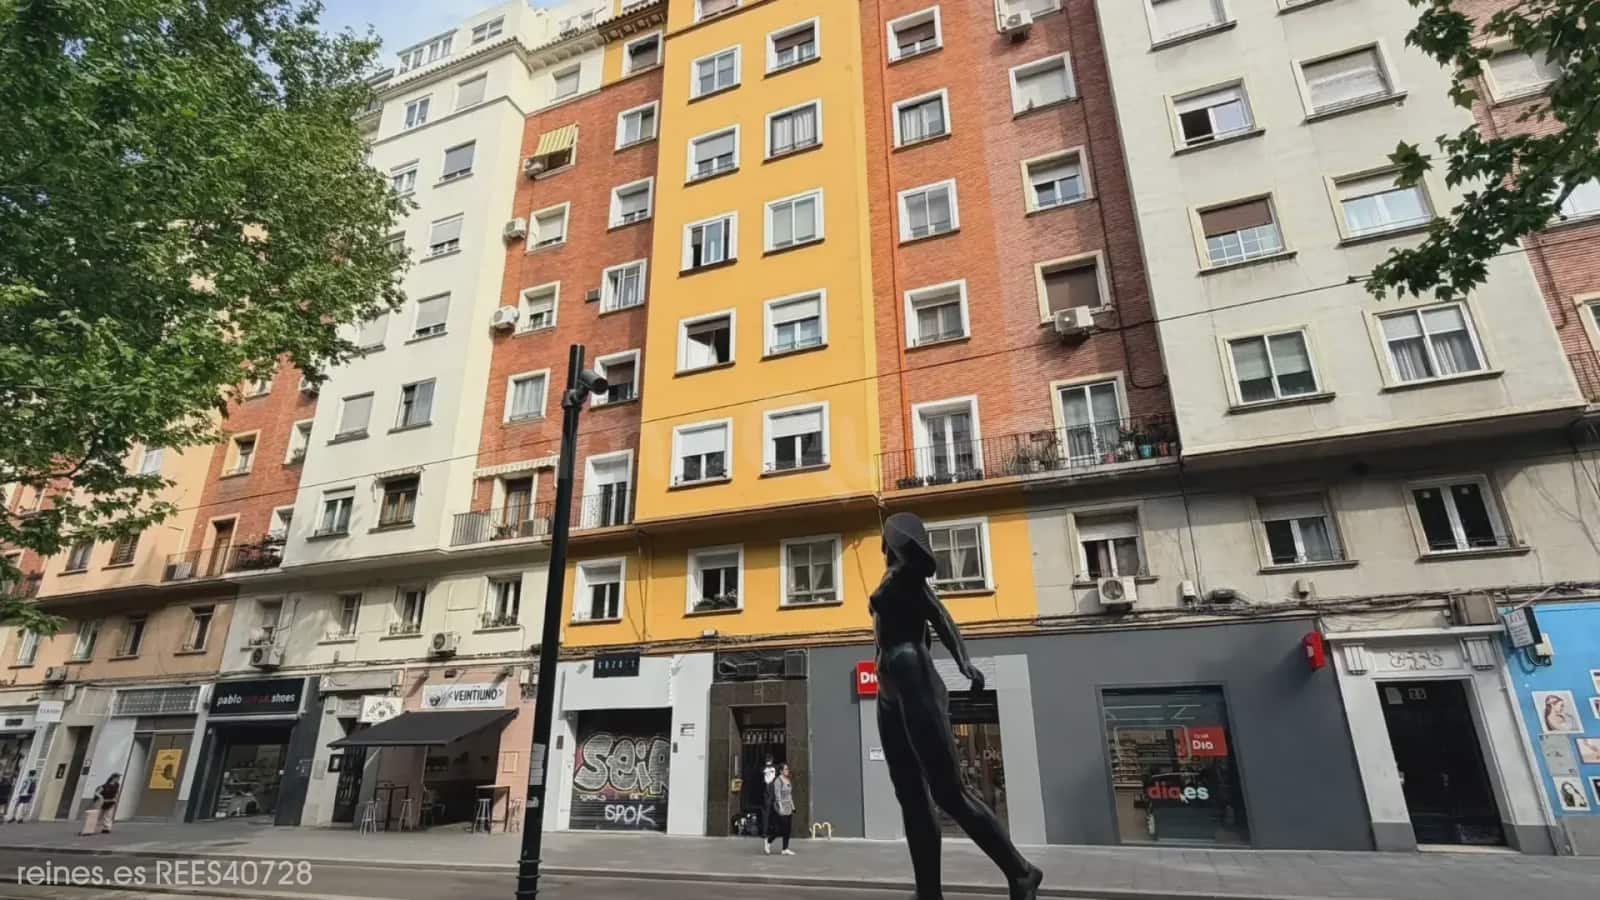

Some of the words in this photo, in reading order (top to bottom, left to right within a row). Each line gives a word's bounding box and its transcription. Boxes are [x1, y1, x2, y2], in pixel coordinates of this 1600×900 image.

[216, 693, 242, 707] pablo
[271, 692, 296, 704] shoes
[453, 688, 498, 701] VEINTIUNO
[604, 804, 657, 825] SPOK
